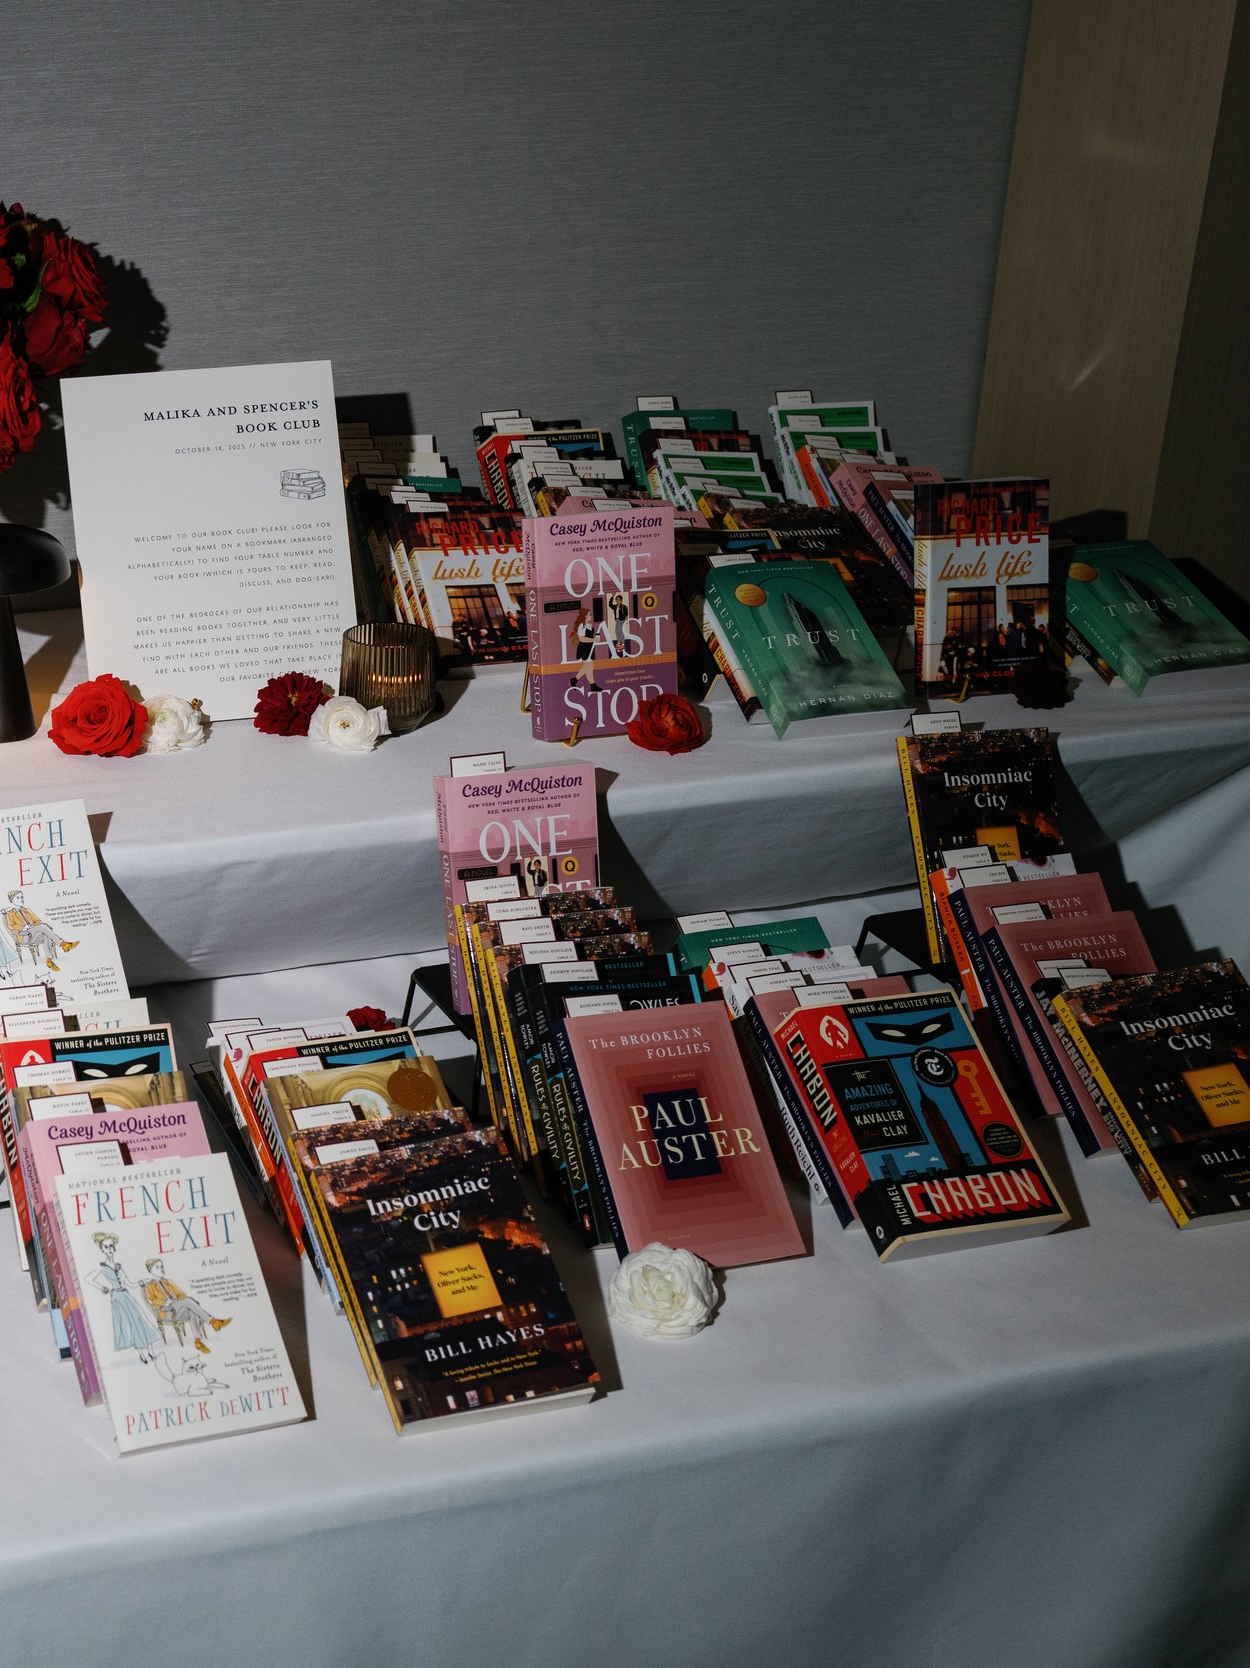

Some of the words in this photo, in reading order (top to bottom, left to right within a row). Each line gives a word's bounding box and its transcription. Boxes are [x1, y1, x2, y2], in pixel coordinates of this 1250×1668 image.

[142, 408, 201, 422] MALIKA
[206, 405, 237, 417] AND
[243, 399, 319, 414] SPENCER'S
[235, 421, 278, 434] BOOK
[282, 418, 321, 431] CLUB
[174, 445, 211, 455] OCTOBER
[227, 443, 245, 451] 2025
[280, 439, 301, 447] YORK
[303, 437, 322, 445] CITY
[937, 498, 997, 517] RICHARD
[133, 534, 172, 543] WELCOME
[190, 531, 207, 539] OUR
[210, 529, 233, 537] BOOK
[260, 524, 287, 533] PLEASE
[291, 522, 313, 531] LOOK
[315, 521, 331, 529] FOR
[549, 519, 588, 536] Casey
[589, 514, 662, 533] McQuiston
[955, 512, 1042, 548] PRICE
[171, 545, 192, 553] YOUR
[195, 543, 217, 551] NAME
[220, 542, 233, 550] ON
[244, 538, 287, 547] BOOKMARK
[126, 559, 194, 570] ALPHABETICALLY)
[233, 553, 254, 561] YOUR
[257, 551, 279, 559] TABLE
[283, 549, 314, 557] NUMBER
[317, 547, 334, 555] AND
[246, 566, 272, 574] YOURS
[937, 548, 989, 583] lush
[995, 548, 1034, 585] life
[238, 579, 273, 588] DISCUSS,
[564, 552, 653, 599] ONE
[644, 596, 654, 608] Q
[558, 614, 669, 665] LAST
[762, 628, 860, 650] TRUST
[798, 693, 857, 708] HERNAN
[861, 690, 895, 700] DIAZ
[462, 783, 503, 799] Casey
[506, 775, 583, 795] McQuiston
[942, 768, 1033, 790] Insomniac
[974, 790, 1008, 811] City
[479, 813, 572, 864] ONE
[17, 849, 88, 887] EXIT
[1119, 1000, 1236, 1038] Insomniac
[587, 1037, 616, 1049] The
[619, 1026, 702, 1046] BROOKLYN
[1167, 1030, 1212, 1053] City
[646, 1041, 711, 1059] FOLLIES
[47, 1122, 94, 1141] Casey
[97, 1111, 187, 1138] McQuiston
[630, 1096, 723, 1133] PAUL
[854, 1109, 905, 1127] KAVALIER
[882, 1123, 909, 1137] CLAY
[618, 1126, 761, 1171] AUSTER
[68, 1177, 118, 1189] NATIONAL
[122, 1168, 182, 1182] BESTSELLER
[71, 1175, 209, 1226] FRENCH
[365, 1174, 492, 1218] Insomniac
[901, 1169, 1042, 1217] CHABON
[888, 1184, 911, 1227] MICHAEL
[412, 1207, 462, 1233] City
[156, 1211, 236, 1255] EXIT
[200, 1259, 207, 1267] A
[208, 1255, 229, 1266] Novel
[437, 1269, 455, 1278] New
[454, 1263, 477, 1273] York,
[436, 1278, 460, 1288] Oliver
[459, 1272, 486, 1283] Sacks,
[450, 1285, 466, 1296] and
[424, 1341, 472, 1362] BILL
[477, 1322, 545, 1350] HAYES
[125, 1400, 211, 1435] PATRICK
